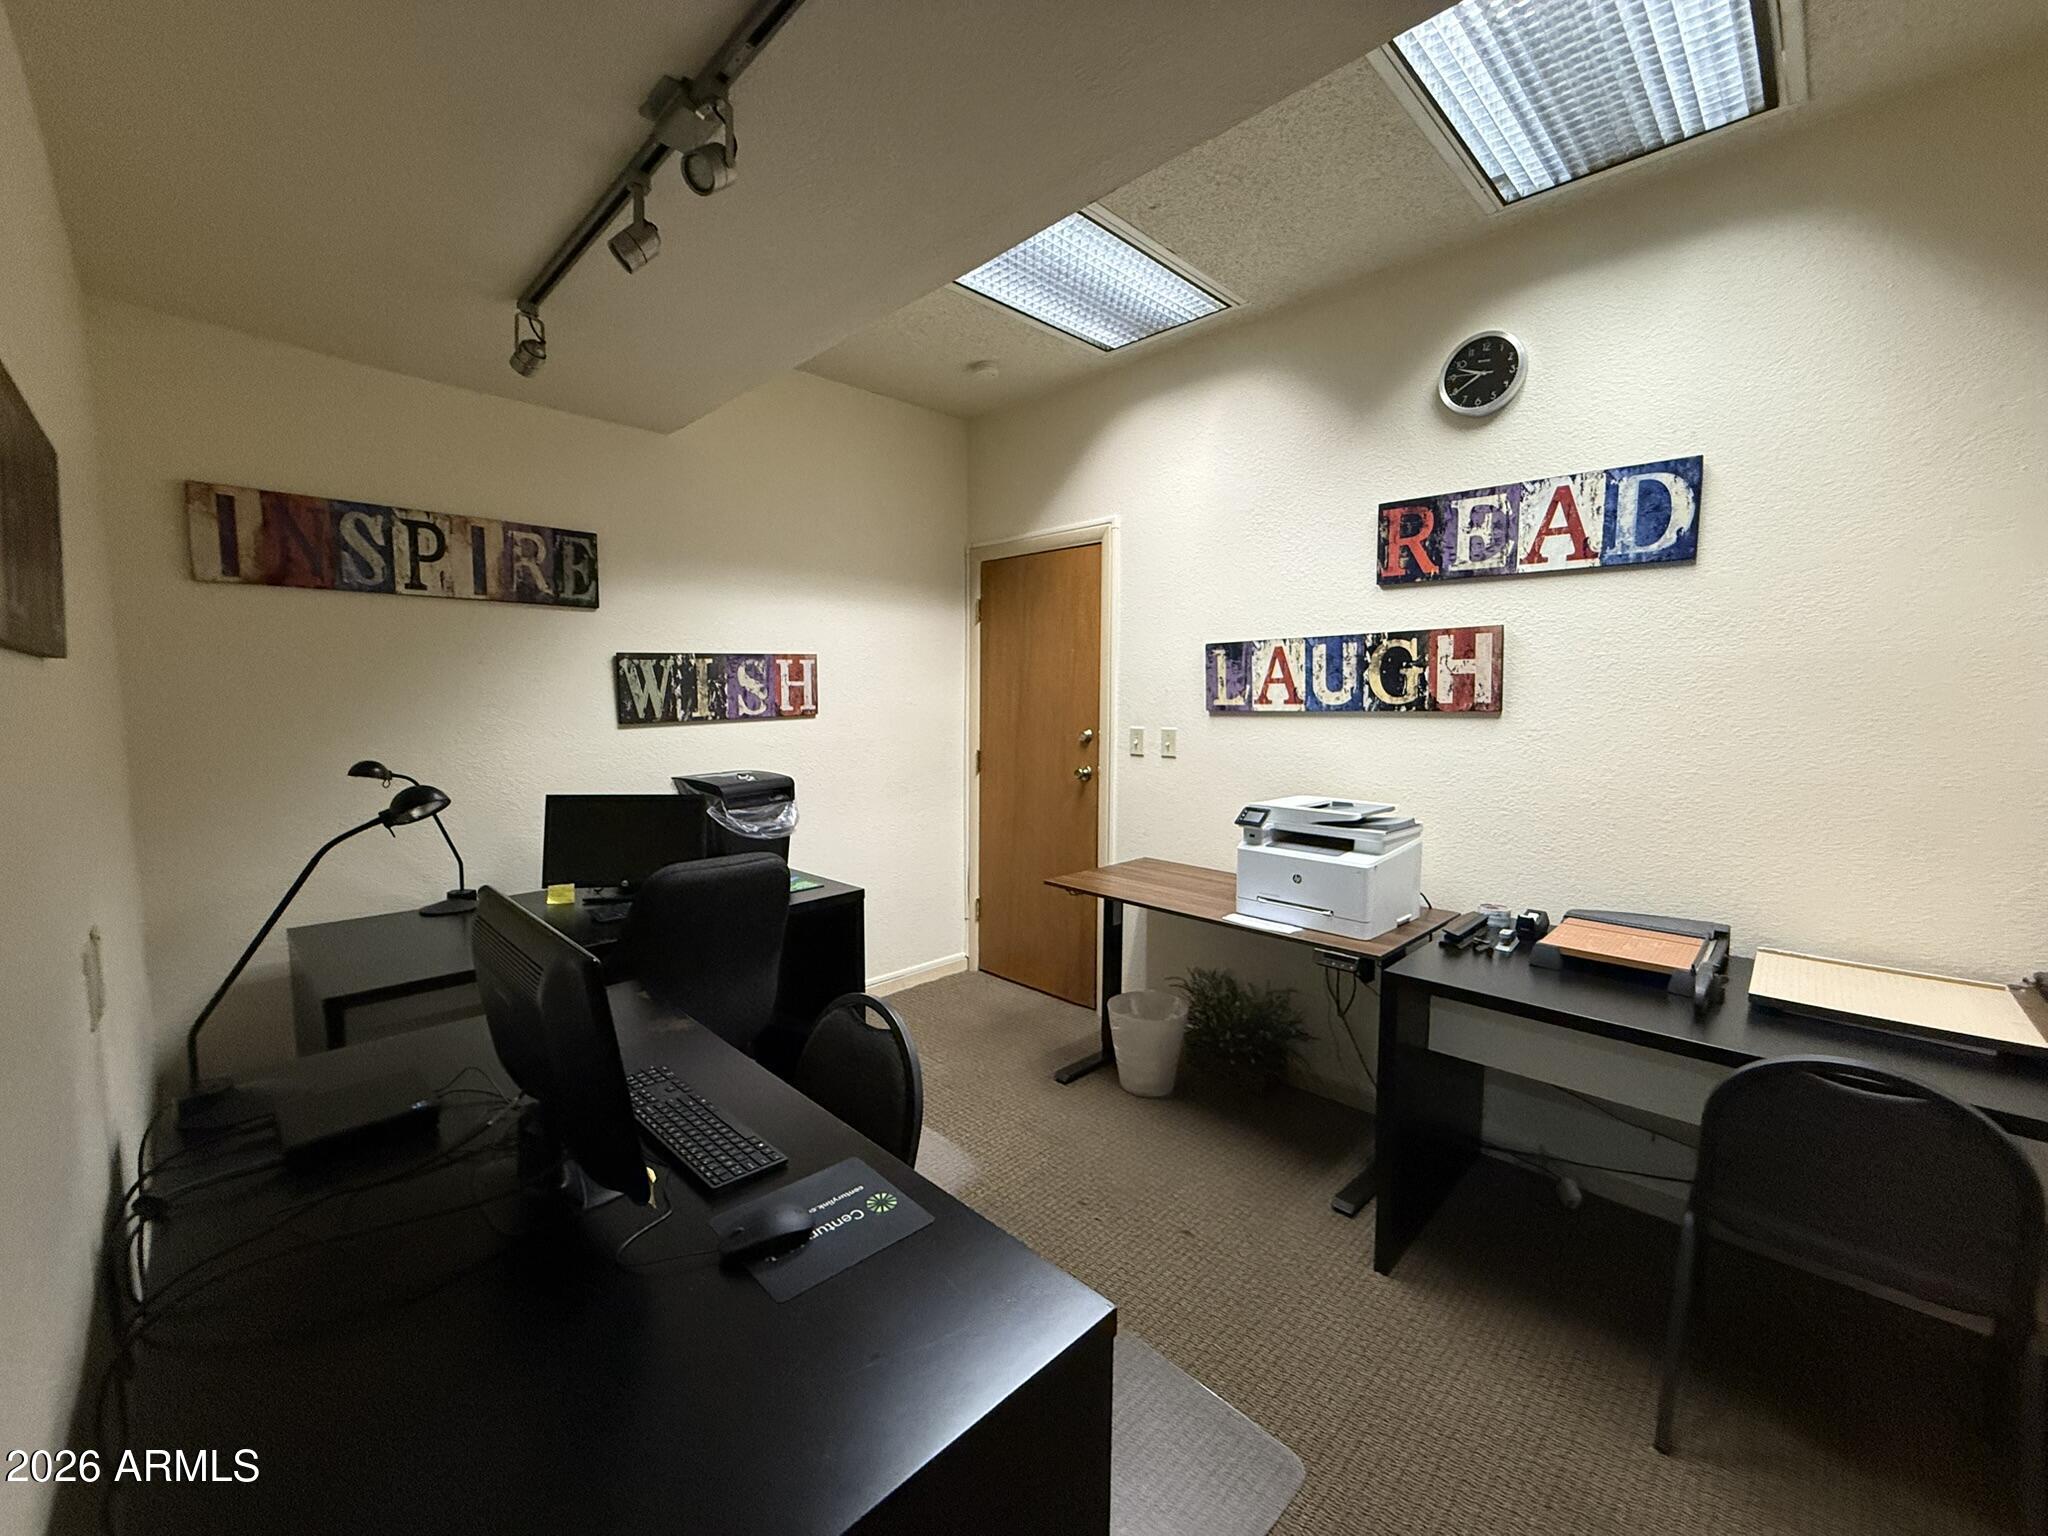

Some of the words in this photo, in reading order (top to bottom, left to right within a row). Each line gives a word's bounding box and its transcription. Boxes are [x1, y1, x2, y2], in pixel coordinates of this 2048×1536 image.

[1508, 352, 1515, 360] 2
[1509, 365, 1516, 373] 3
[1474, 397, 1482, 406] 6
[1490, 391, 1497, 399] 5
[1380, 471, 1697, 578] READ
[214, 492, 597, 598] INSPIRE
[1212, 632, 1493, 707] LAUGH
[618, 657, 816, 721] WISH
